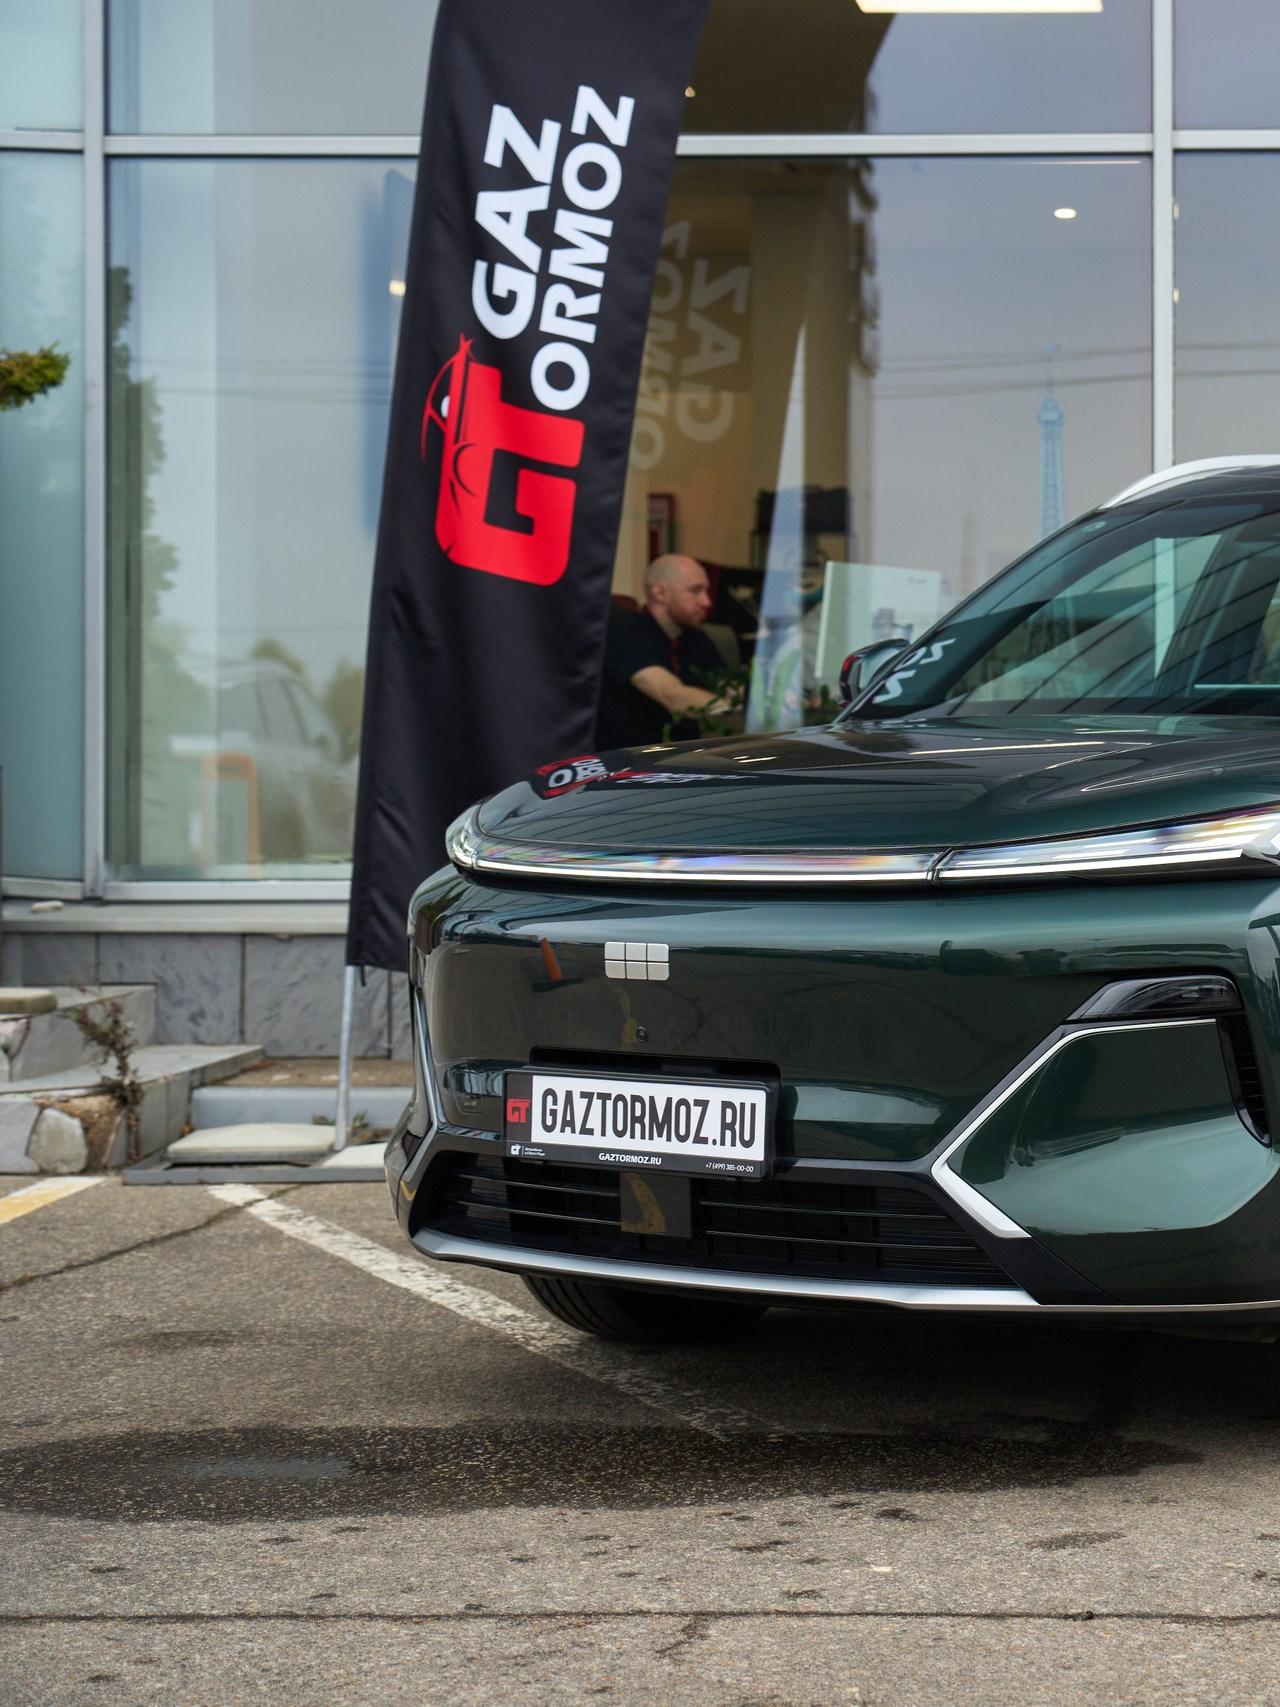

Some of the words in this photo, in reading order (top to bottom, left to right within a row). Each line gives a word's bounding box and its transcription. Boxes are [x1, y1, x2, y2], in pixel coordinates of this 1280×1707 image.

[472, 105, 561, 339] GAZ
[540, 1087, 757, 1149] GAZTORMOZ.RU
[598, 1152, 662, 1166] GAZTORMOZ.RU
